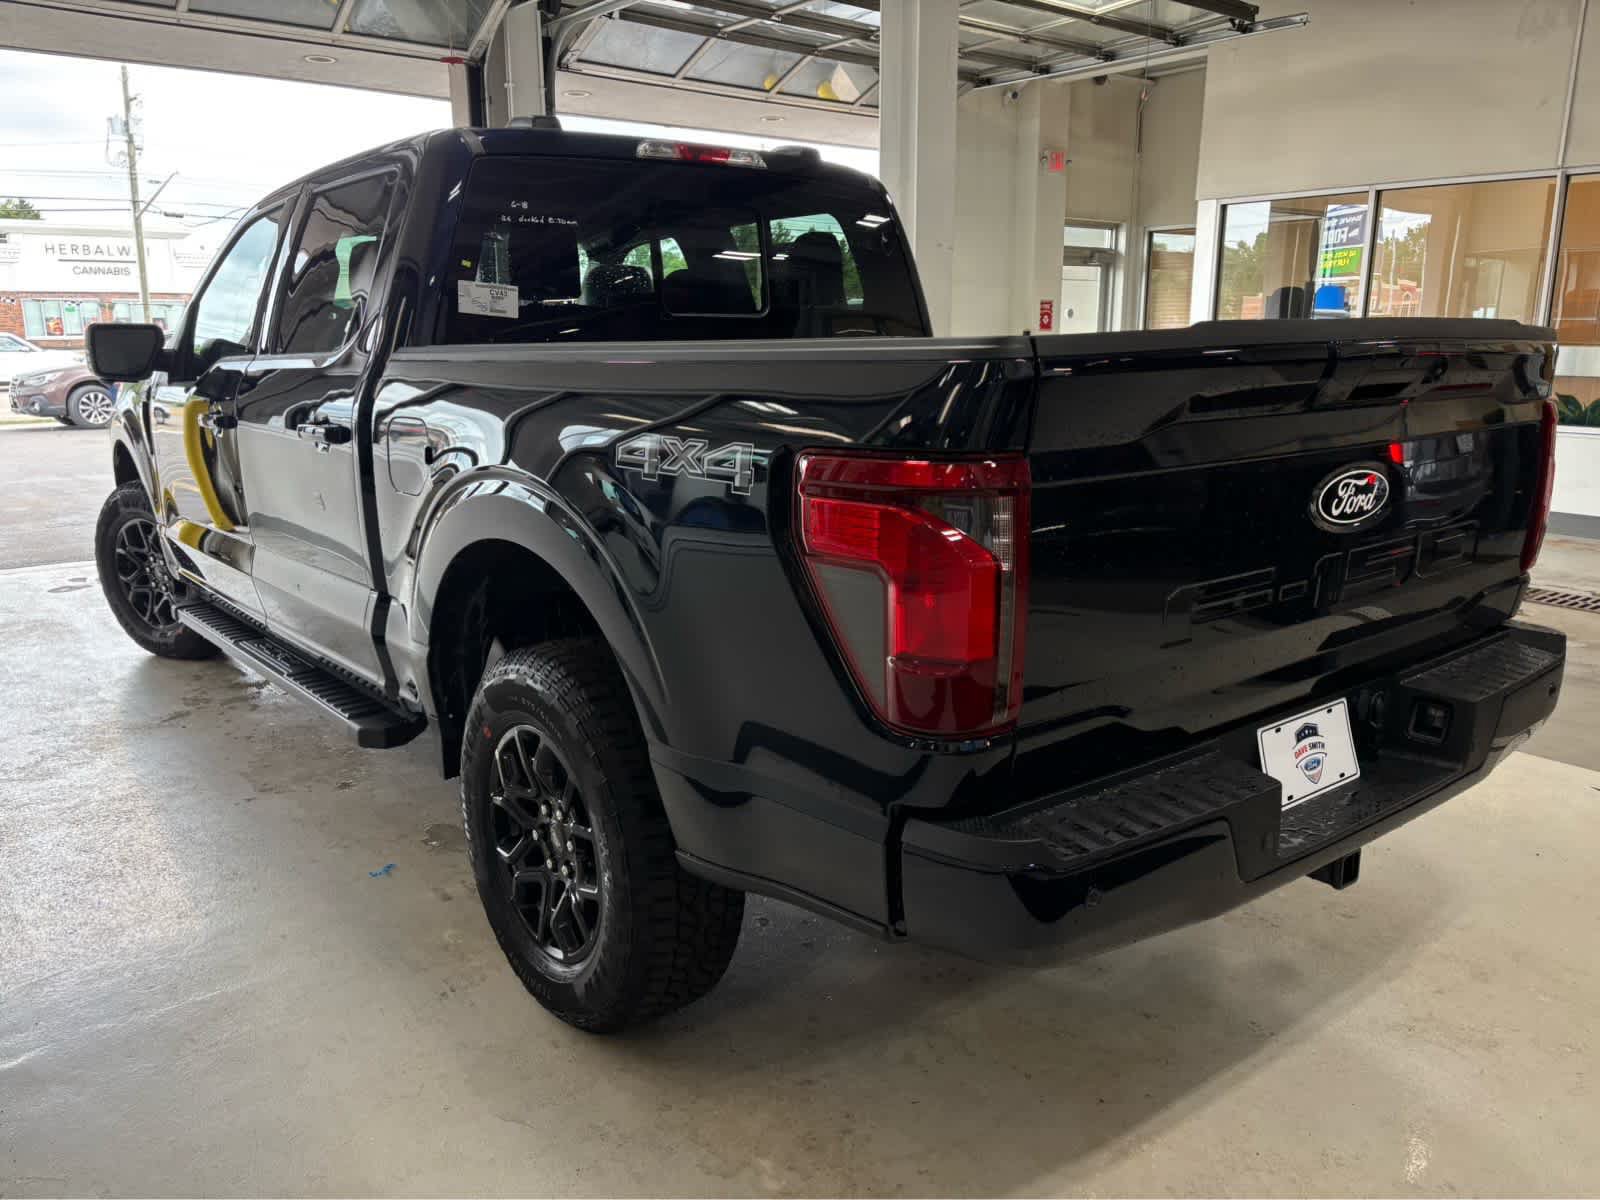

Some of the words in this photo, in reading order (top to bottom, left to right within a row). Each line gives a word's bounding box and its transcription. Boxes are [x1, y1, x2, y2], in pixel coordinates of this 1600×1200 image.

[72, 266, 131, 276] CANNABIS
[616, 433, 755, 496] 4X4
[1331, 476, 1377, 516] Ford
[1295, 745, 1309, 759] DAVE
[1308, 741, 1325, 750] SMITH
